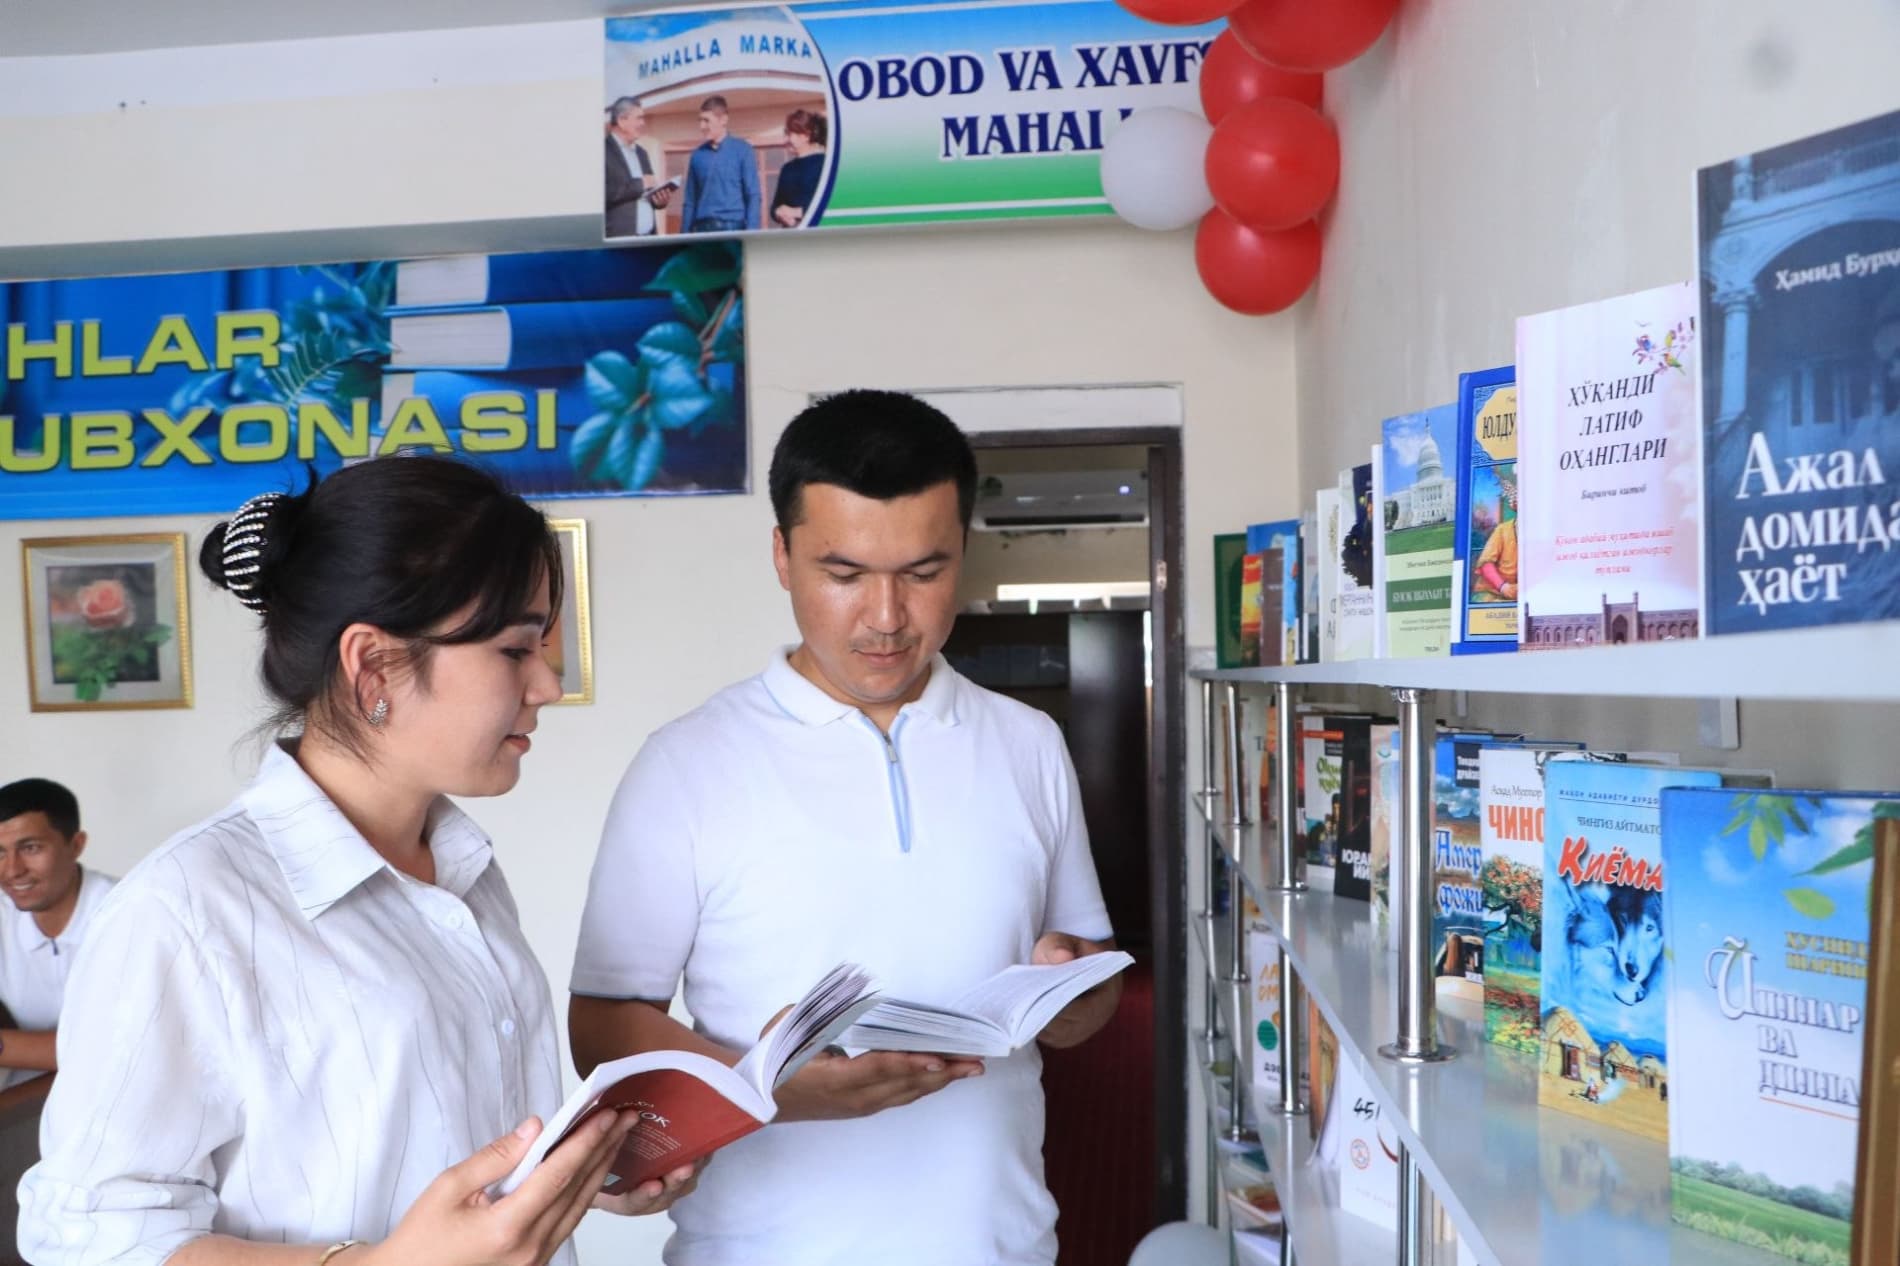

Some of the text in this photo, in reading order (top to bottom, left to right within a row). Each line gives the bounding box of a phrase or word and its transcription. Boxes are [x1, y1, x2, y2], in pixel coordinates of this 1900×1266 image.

[639, 35, 812, 79] MAHALLA MARKA
[838, 55, 984, 102] OBOD
[999, 48, 1063, 92] VA
[943, 107, 1135, 159] MAHAL
[8, 312, 280, 381] HLAR
[0, 388, 558, 472] UBXONASI
[1578, 409, 1643, 437] ЛАТИФ
[1735, 432, 1886, 499] Ажал
[1737, 553, 1848, 616] ҳаёт
